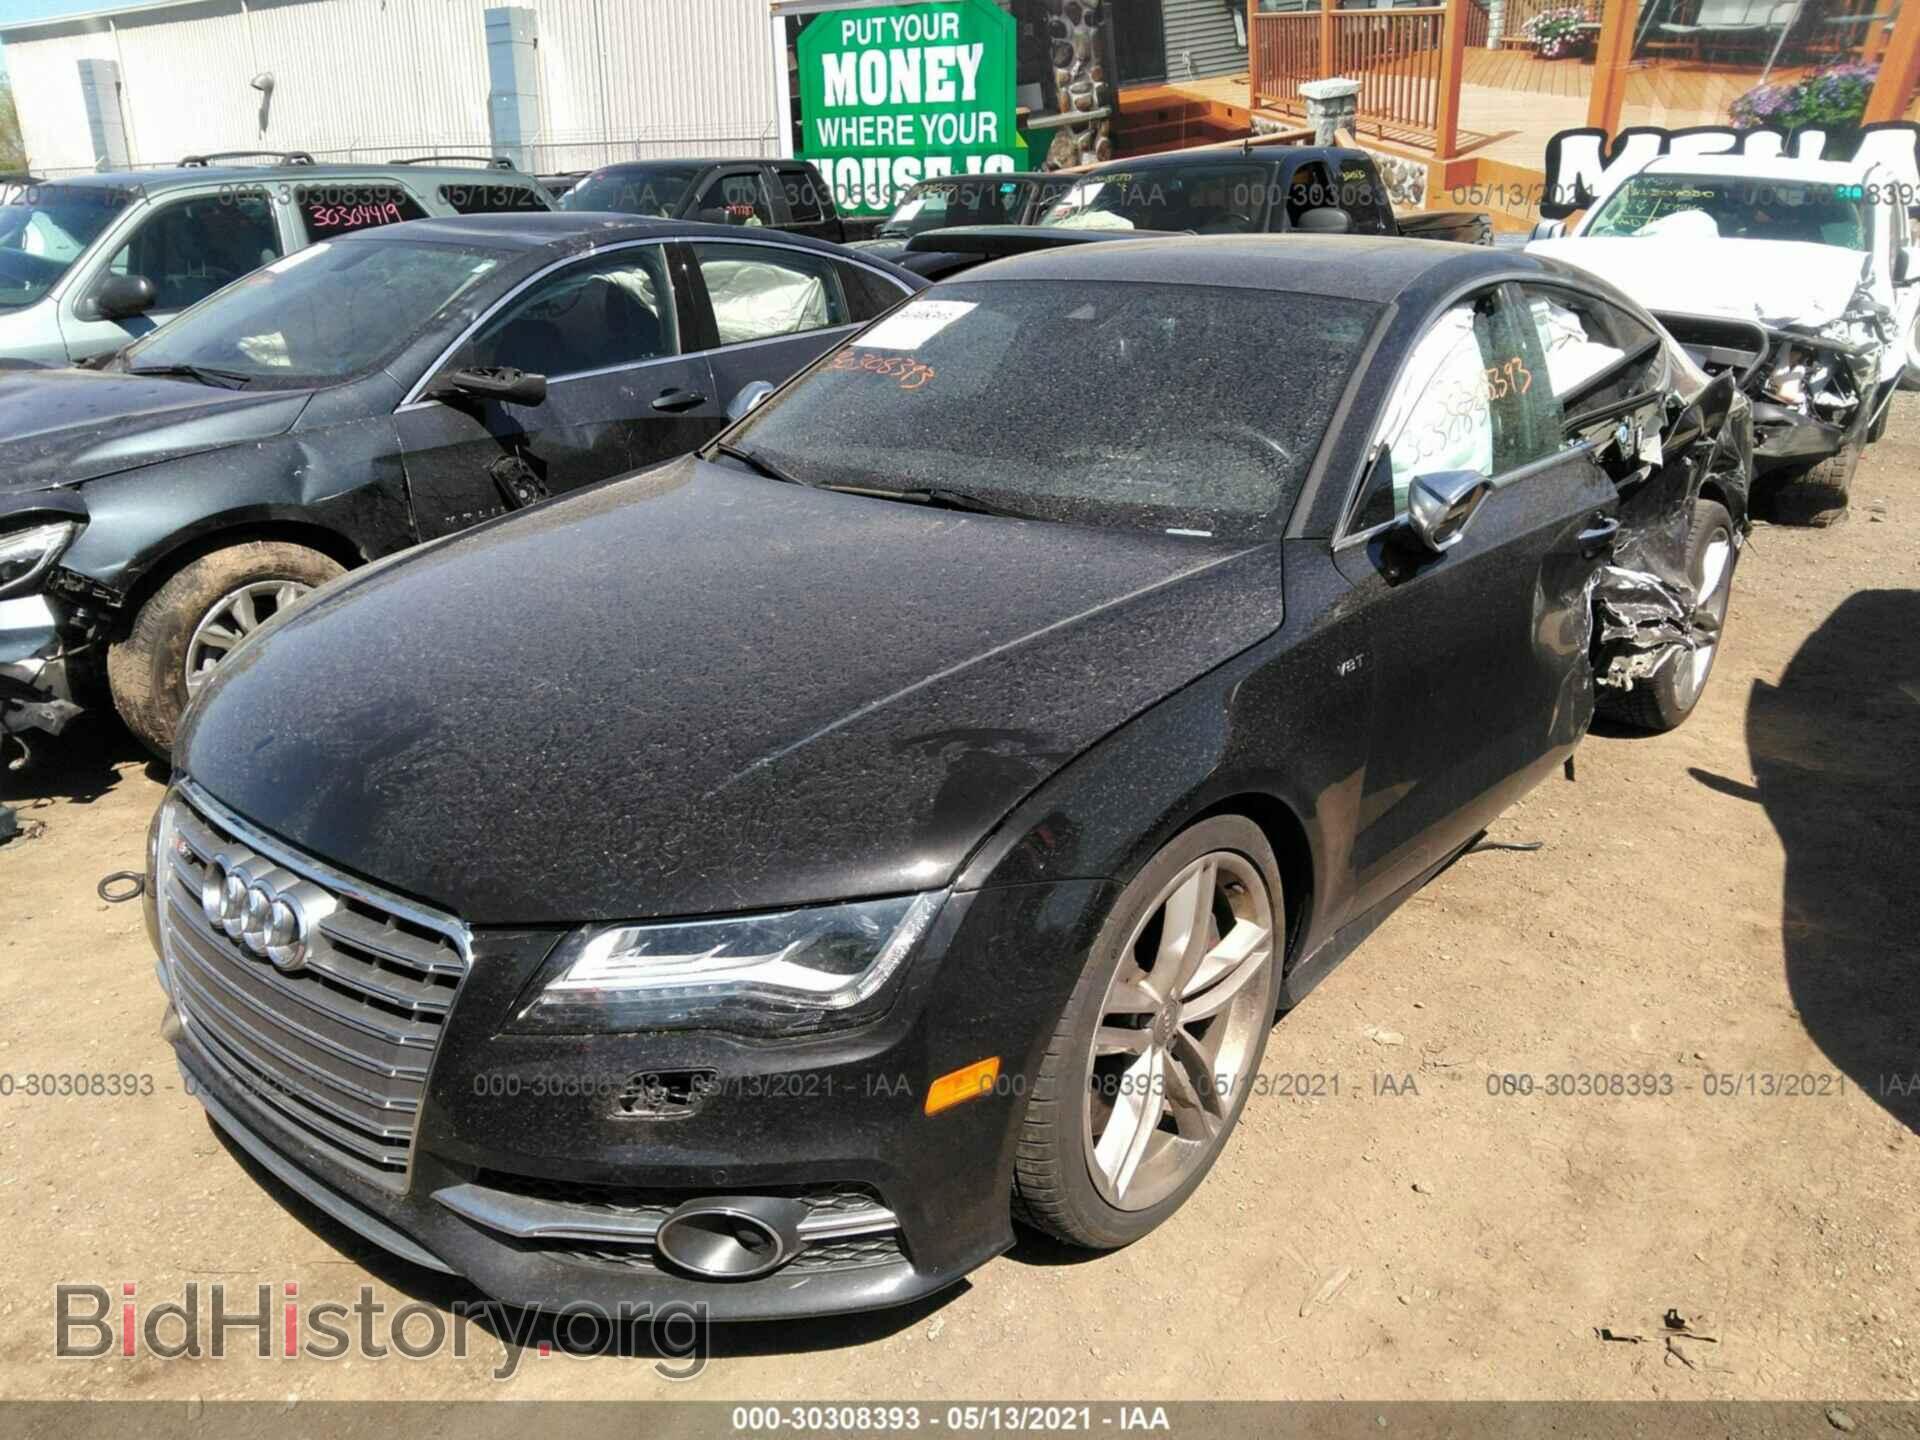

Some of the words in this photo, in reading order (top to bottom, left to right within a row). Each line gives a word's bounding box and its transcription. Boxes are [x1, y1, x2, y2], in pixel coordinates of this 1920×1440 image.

[842, 17, 886, 45] PUT
[891, 12, 960, 41] YOUR
[822, 43, 984, 107] MONEY
[816, 115, 915, 147] WHERE
[921, 111, 998, 145] YOUR
